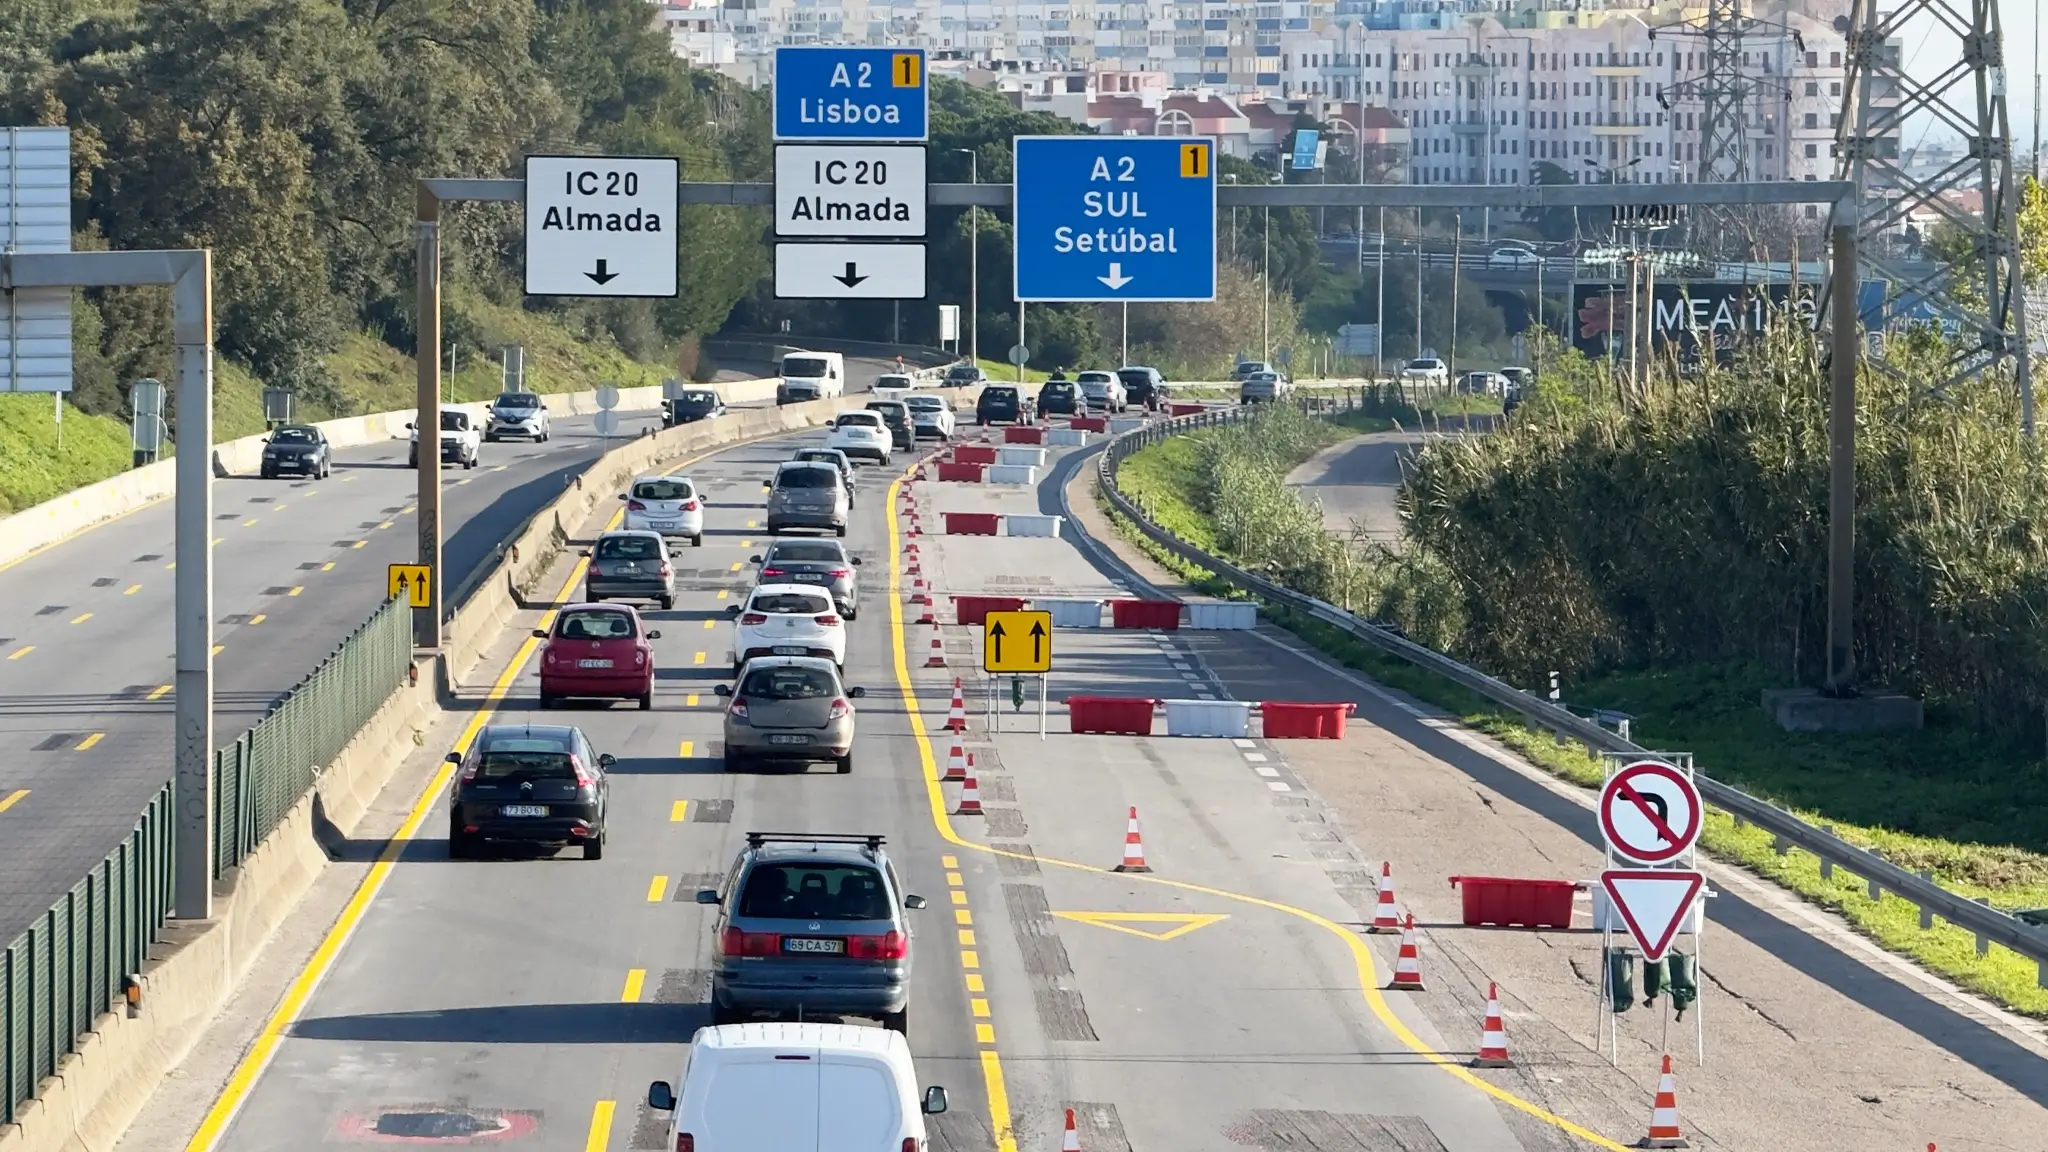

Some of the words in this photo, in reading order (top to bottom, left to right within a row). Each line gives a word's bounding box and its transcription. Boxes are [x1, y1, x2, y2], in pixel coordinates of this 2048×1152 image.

[901, 56, 912, 86] 1
[800, 97, 901, 124] Lisboa
[1189, 147, 1200, 175] 1
[792, 196, 909, 223] Almada
[1083, 191, 1147, 217] SUL
[542, 207, 662, 233] Almada
[1054, 226, 1178, 253] Setúbal
